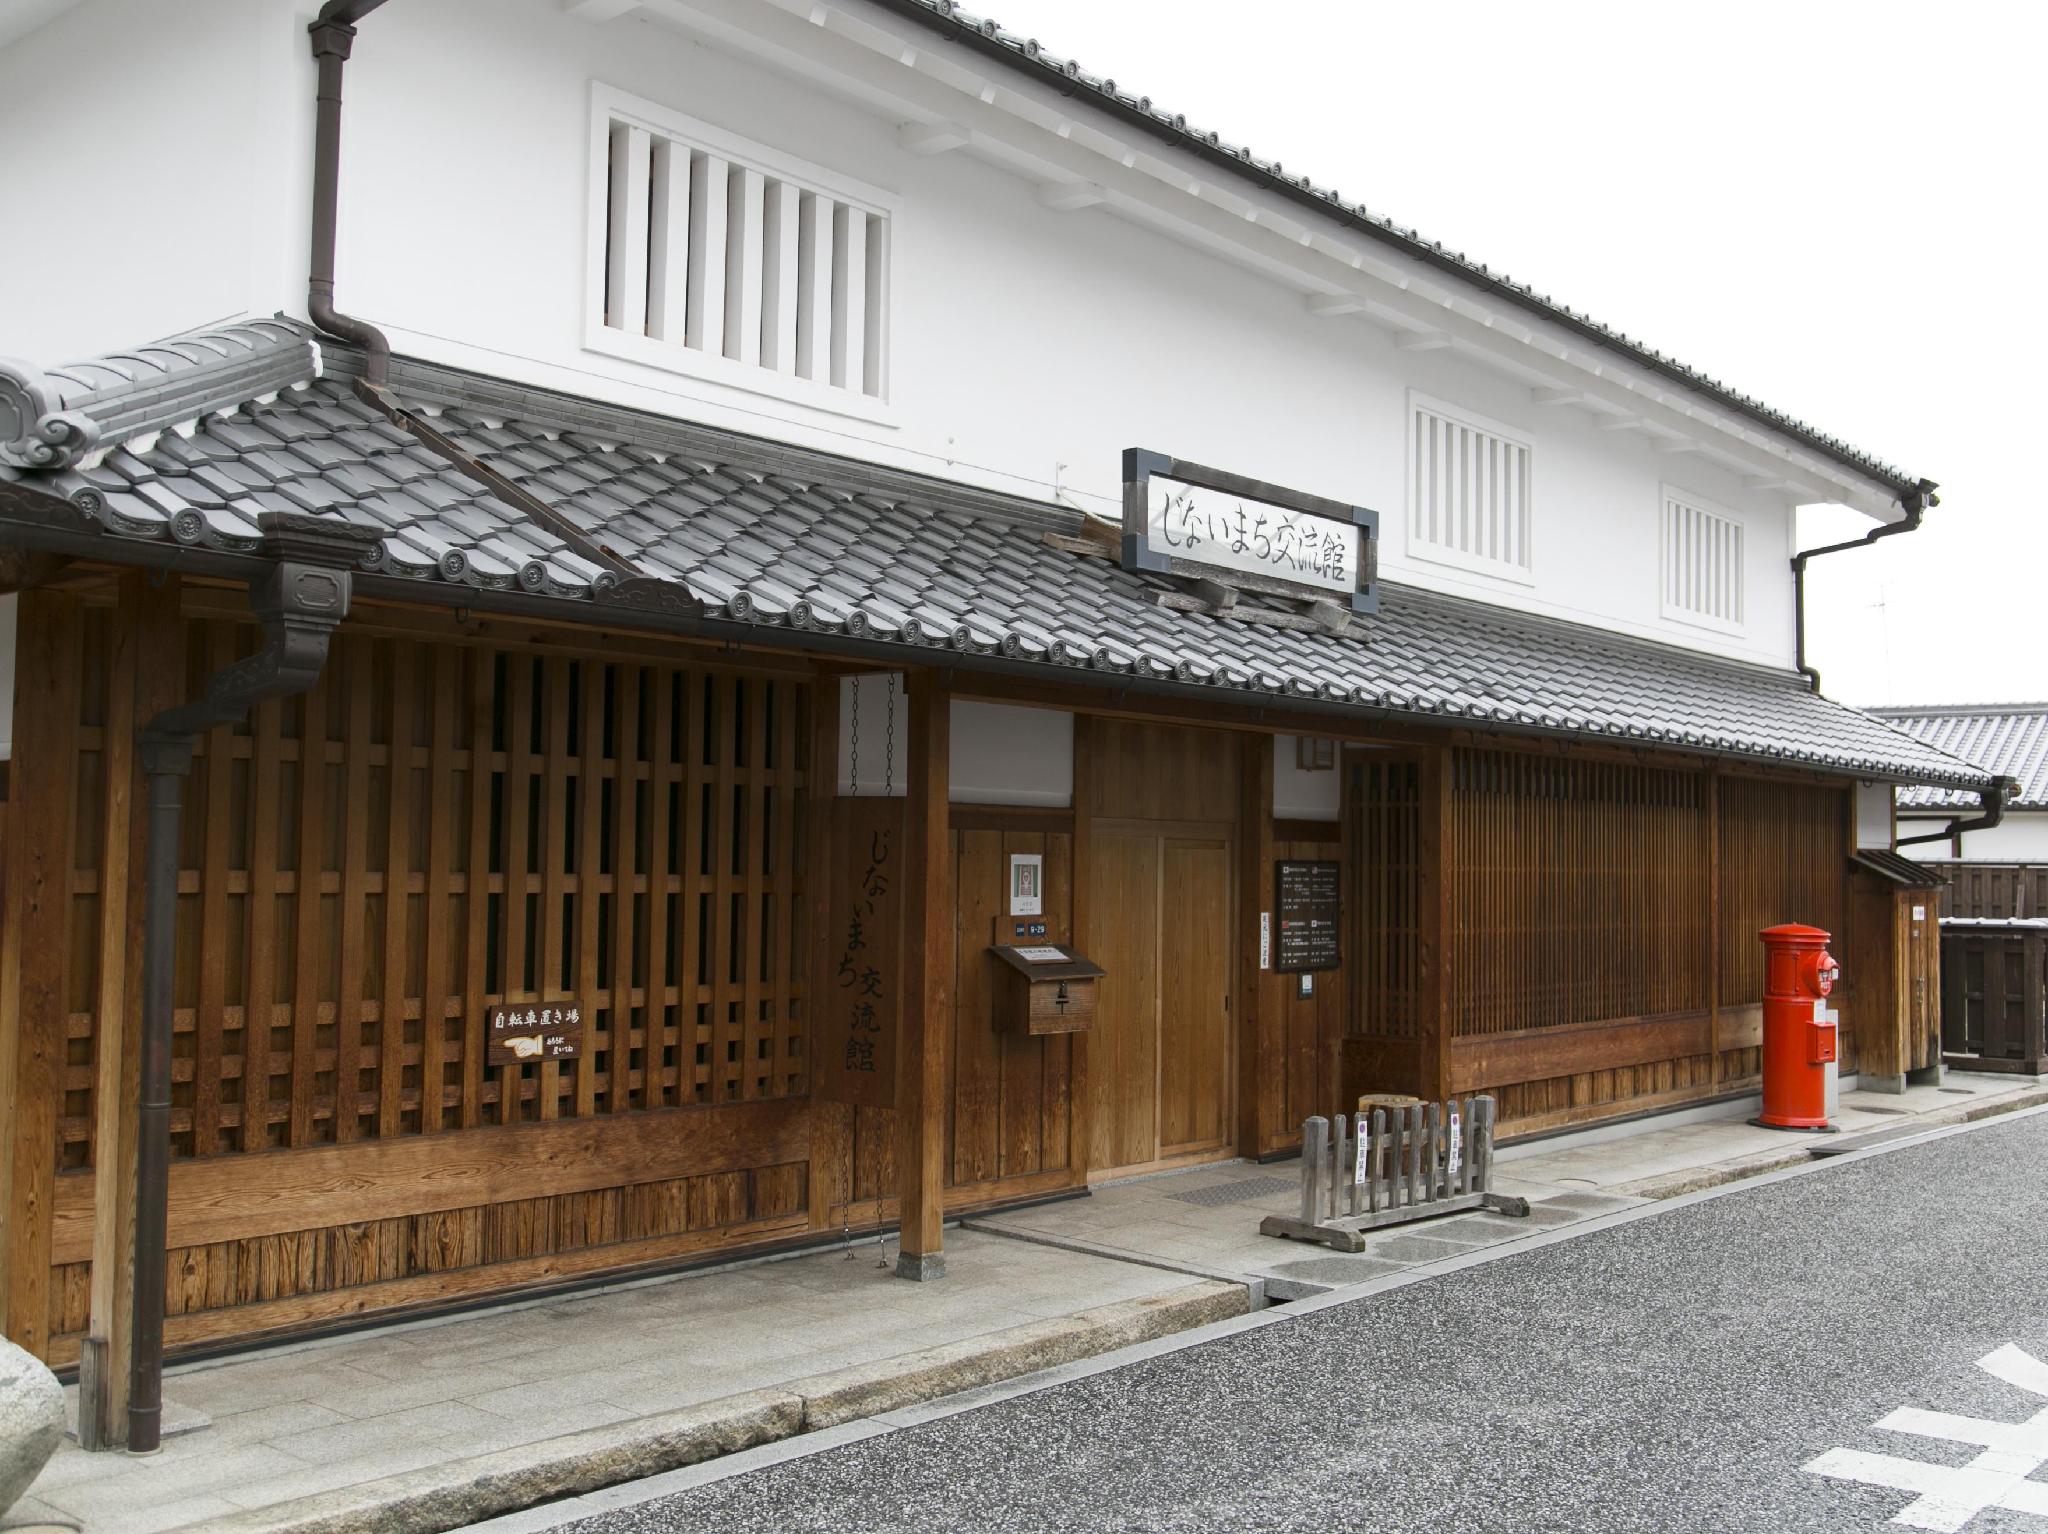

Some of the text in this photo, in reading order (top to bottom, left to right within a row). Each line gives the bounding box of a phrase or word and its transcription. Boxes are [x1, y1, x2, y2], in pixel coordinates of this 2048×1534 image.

[1164, 492, 1346, 582] じないまち交流館
[838, 829, 892, 1073] じないまち交流館
[495, 1008, 580, 1029] 自転車置き場
